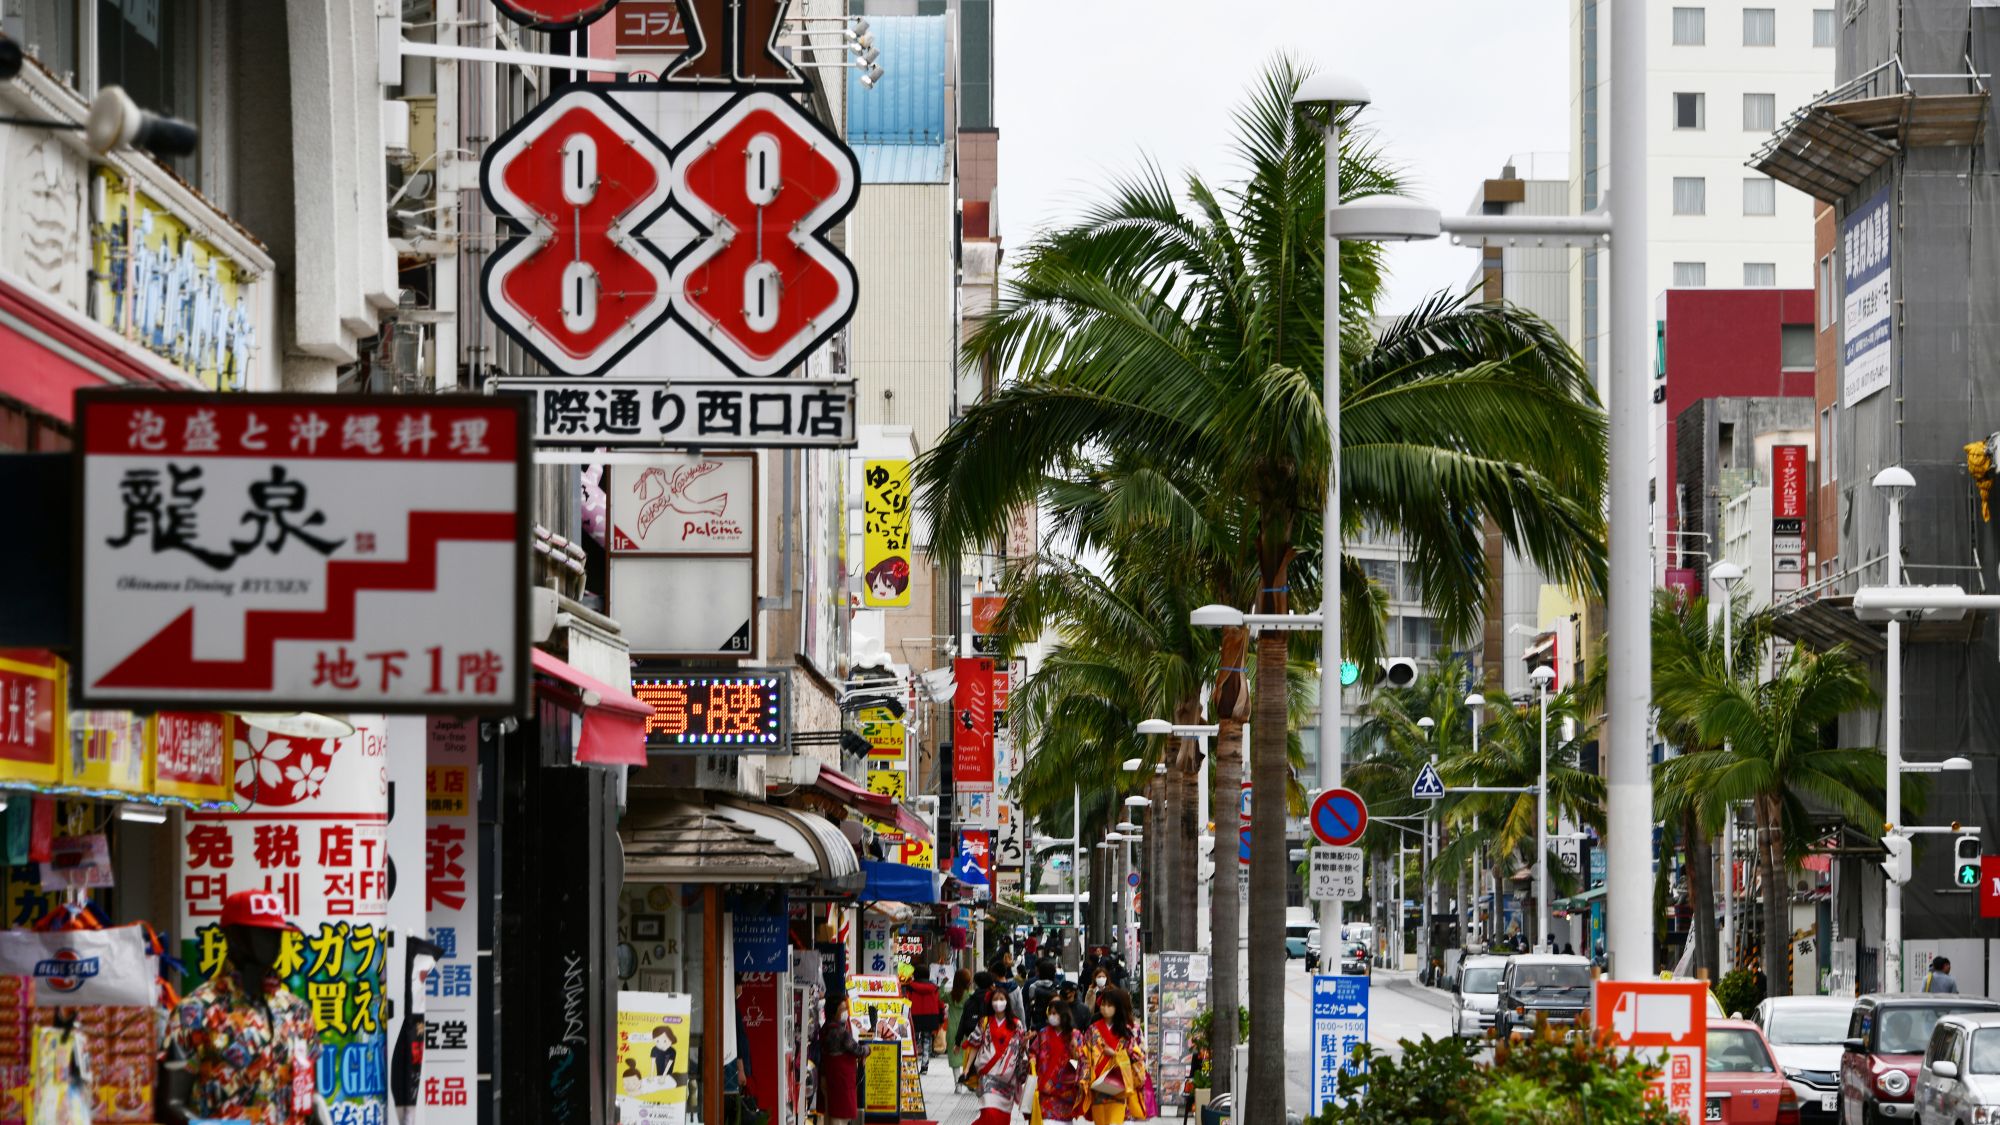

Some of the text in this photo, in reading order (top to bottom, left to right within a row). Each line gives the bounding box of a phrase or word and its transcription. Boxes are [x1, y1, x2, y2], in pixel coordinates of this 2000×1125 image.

[542, 388, 847, 436] 際通り西口店
[127, 408, 491, 456] 泡盛と沖縄料理
[106, 463, 347, 571] 龍泉
[682, 521, 743, 541] Paloma
[615, 537, 629, 550] 1F
[116, 576, 311, 596] Okinawa Dining RYUSEN
[731, 637, 749, 649] B1
[312, 645, 504, 696] 地下1階
[357, 727, 388, 756] Tax-
[444, 743, 467, 754] Shop
[958, 764, 981, 772] Dining
[186, 824, 354, 869] 免税店
[1314, 851, 1360, 860] 貨物集配中の
[1314, 863, 1360, 872] 貨物車を除く
[1320, 876, 1329, 885] 10
[1344, 876, 1354, 885] 15
[1316, 888, 1355, 897] ここから
[38, 960, 97, 975] BLUE SEAL
[1315, 1003, 1346, 1015] ここから
